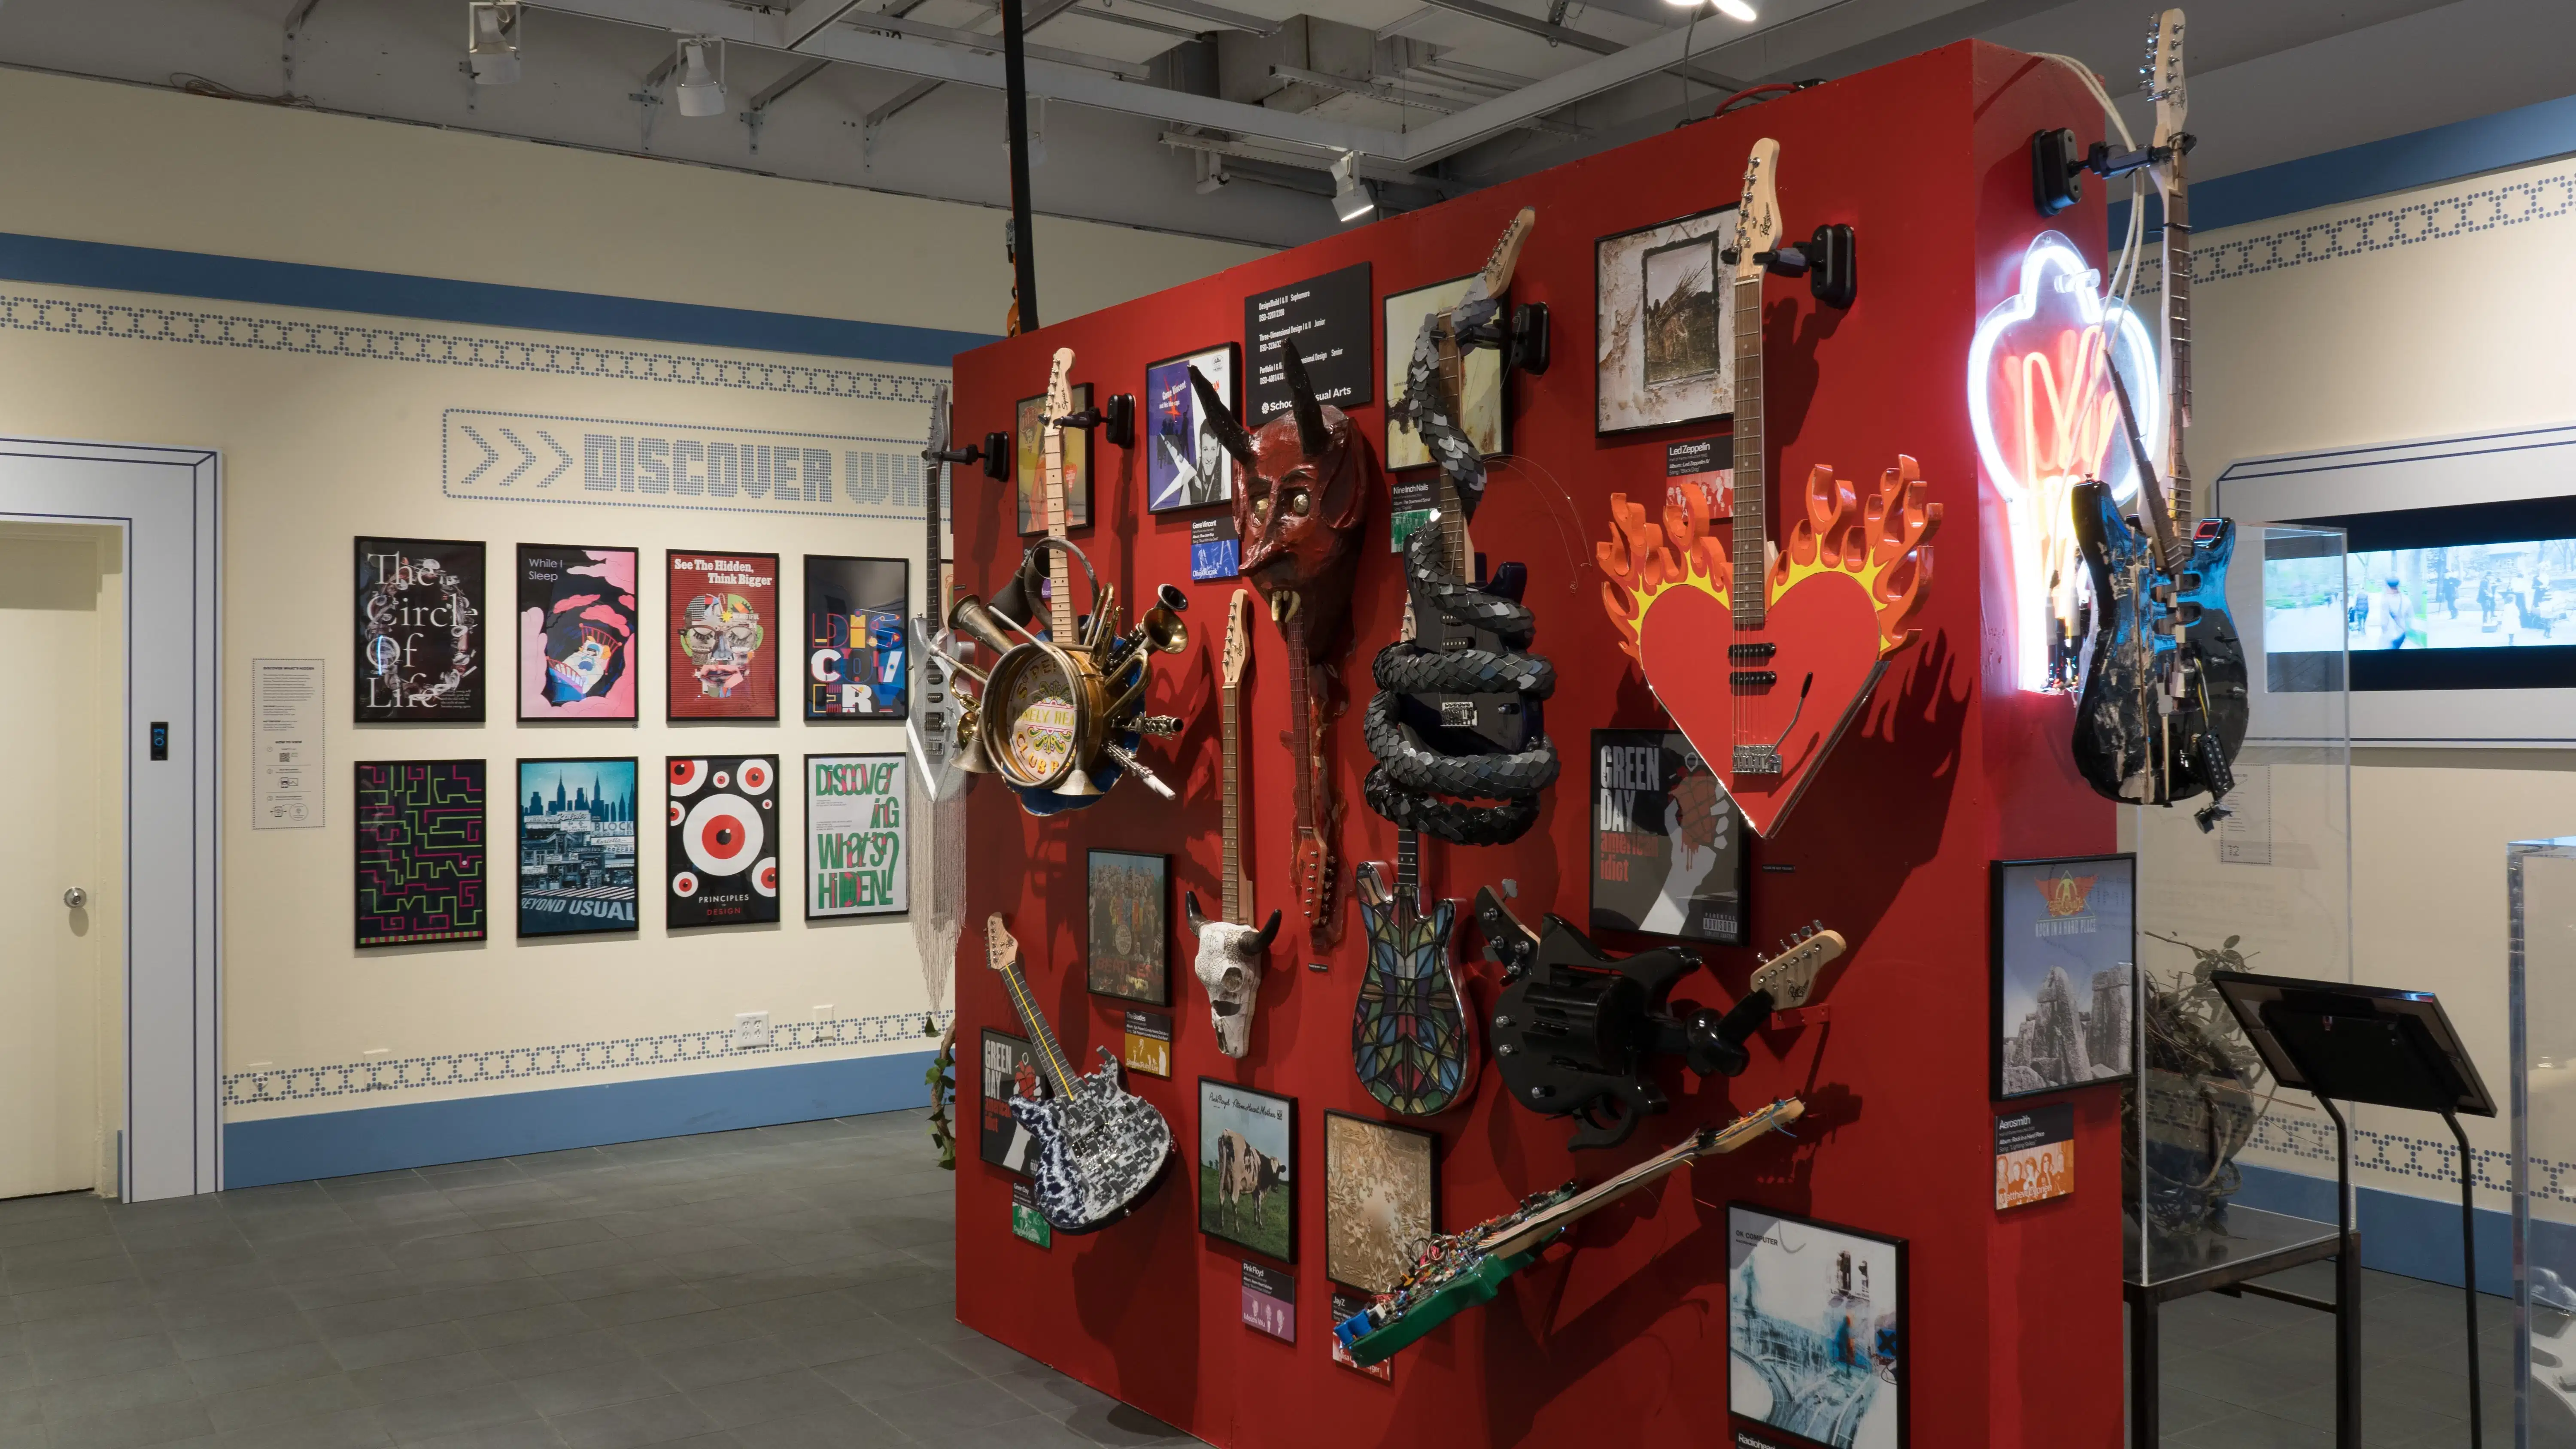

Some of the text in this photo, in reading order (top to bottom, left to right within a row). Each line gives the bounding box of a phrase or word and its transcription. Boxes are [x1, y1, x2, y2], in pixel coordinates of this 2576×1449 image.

[1291, 291, 1310, 302] Sophomore
[1259, 326, 1291, 342] Three-Dimensional
[1291, 324, 1303, 333] Design
[1314, 318, 1326, 327] Junior
[1260, 364, 1273, 374] Portfolio
[1315, 352, 1327, 361] Design
[1331, 348, 1343, 357] Senior
[1162, 379, 1186, 400] Gene Vincent
[1333, 387, 1351, 398] Arts
[1669, 443, 1710, 455] Led Zeppelin
[584, 434, 832, 503] DISCOVER
[1405, 485, 1416, 493] Inch
[1416, 483, 1429, 491] Nails
[368, 551, 434, 586] The
[529, 558, 563, 569] While I
[674, 558, 754, 574] See The Hidden,
[529, 570, 558, 582] Sleep
[707, 572, 772, 588] Think Bigger
[367, 593, 478, 627] Circle
[366, 633, 424, 670] Of
[1017, 731, 1047, 775] CLUB
[1601, 746, 1660, 791] GREEN
[1600, 788, 1636, 833] DAY
[594, 821, 634, 831] BLOCK
[1601, 832, 1659, 857] american
[1601, 853, 1629, 882] idiot
[699, 894, 749, 903] PRINCIPLES
[568, 900, 635, 921] USUAL
[707, 907, 741, 915] DESIGN
[2035, 918, 2096, 937] ROCK IN A HARD PLACE
[1133, 1012, 1146, 1022] Beatles
[985, 1039, 1012, 1074] GREEN
[985, 1067, 1001, 1100] DAY
[1209, 1092, 1218, 1103] Pink
[1245, 1101, 1260, 1114] Heart
[1259, 1104, 1276, 1119] Mother
[1999, 1115, 2031, 1130] Aerosmith
[1746, 1232, 1778, 1246] COMPUTER
[1243, 1263, 1264, 1277] Pink Floyd
[1333, 1296, 1341, 1307] Jay
[1258, 1317, 1266, 1328] Wu
